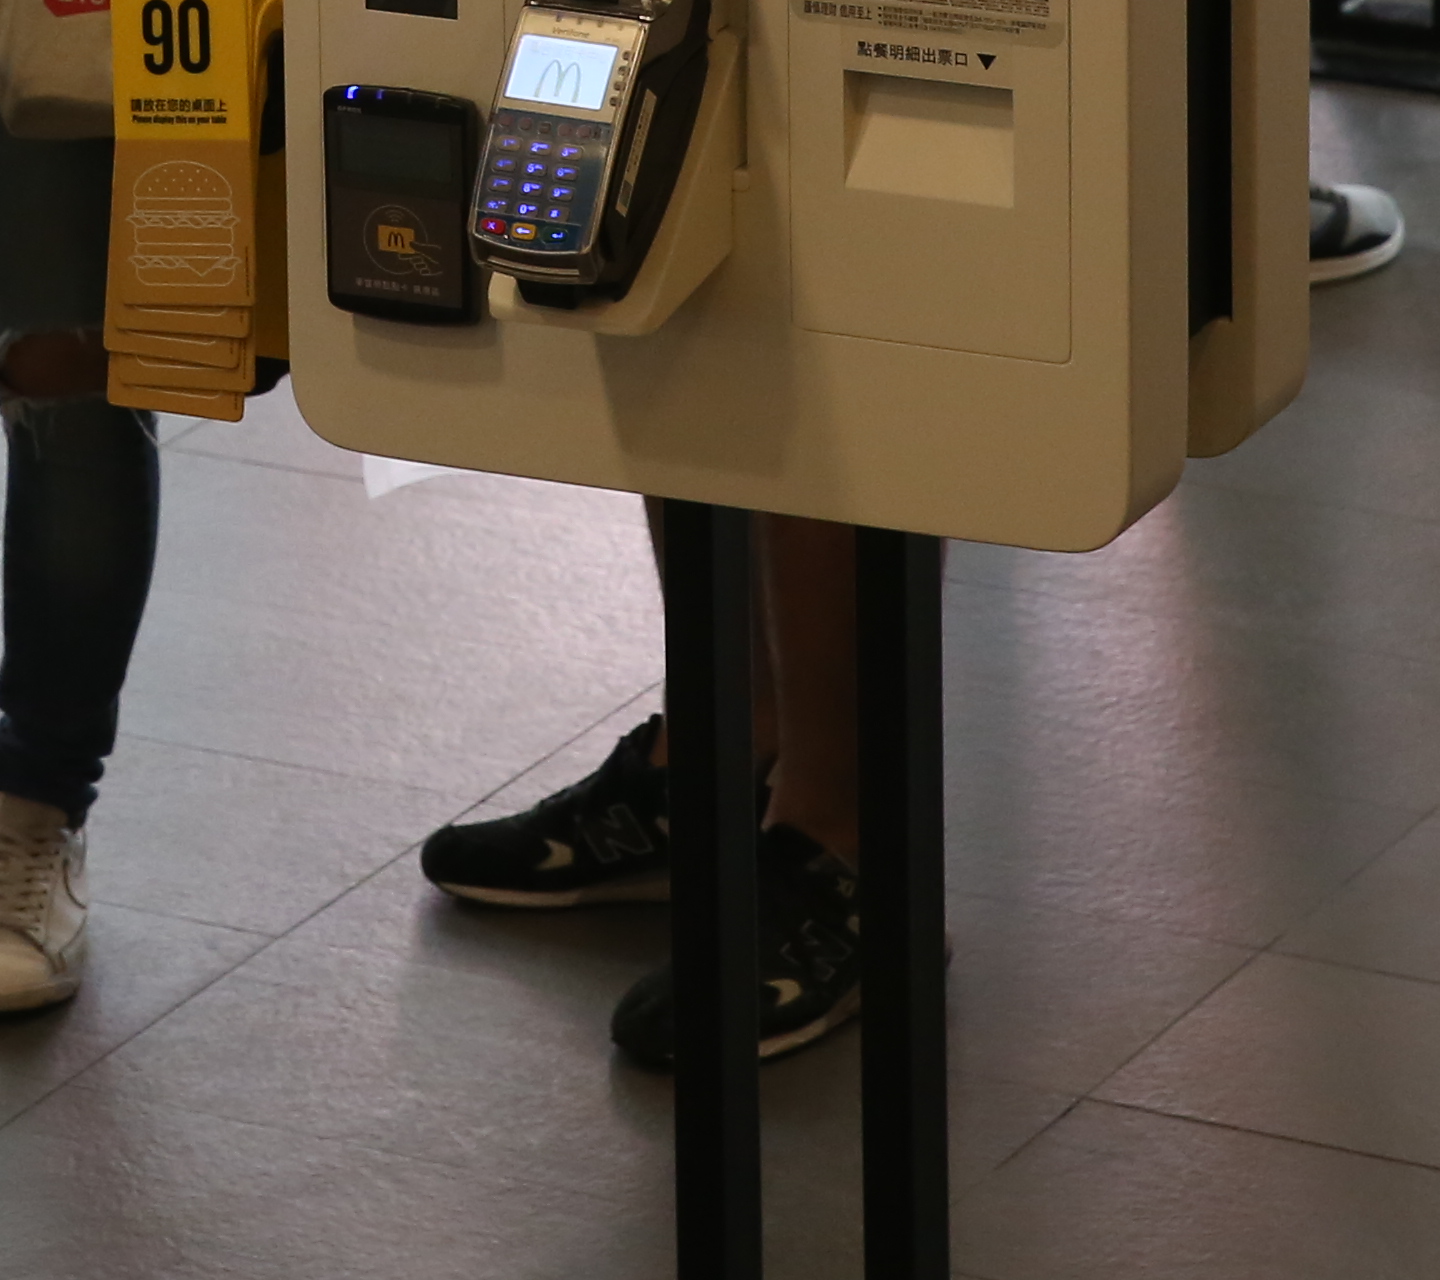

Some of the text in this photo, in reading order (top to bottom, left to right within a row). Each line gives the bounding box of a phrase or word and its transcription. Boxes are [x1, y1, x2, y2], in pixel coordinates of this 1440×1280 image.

[857, 41, 969, 67] 點餐明細出票口
